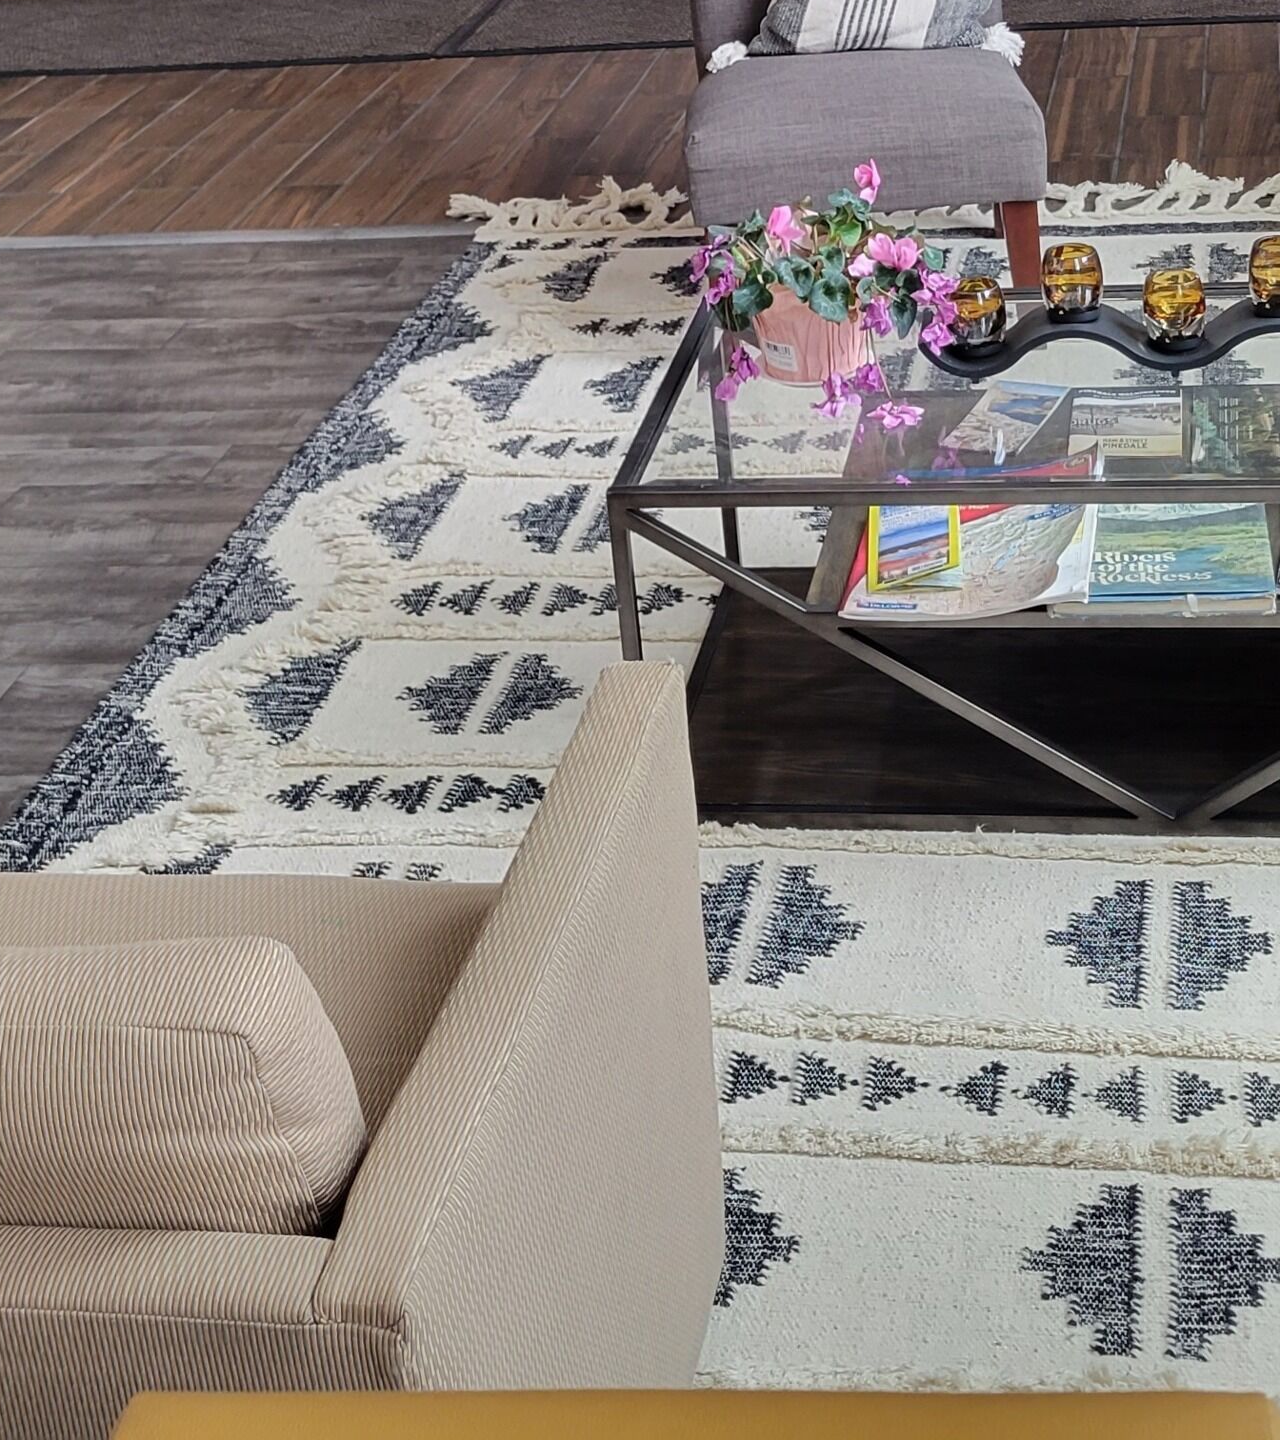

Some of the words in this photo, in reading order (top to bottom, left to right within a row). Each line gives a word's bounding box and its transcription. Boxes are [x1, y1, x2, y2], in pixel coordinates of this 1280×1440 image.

[1095, 551, 1177, 565] Rivers
[1098, 562, 1124, 574] of
[1128, 560, 1169, 573] the
